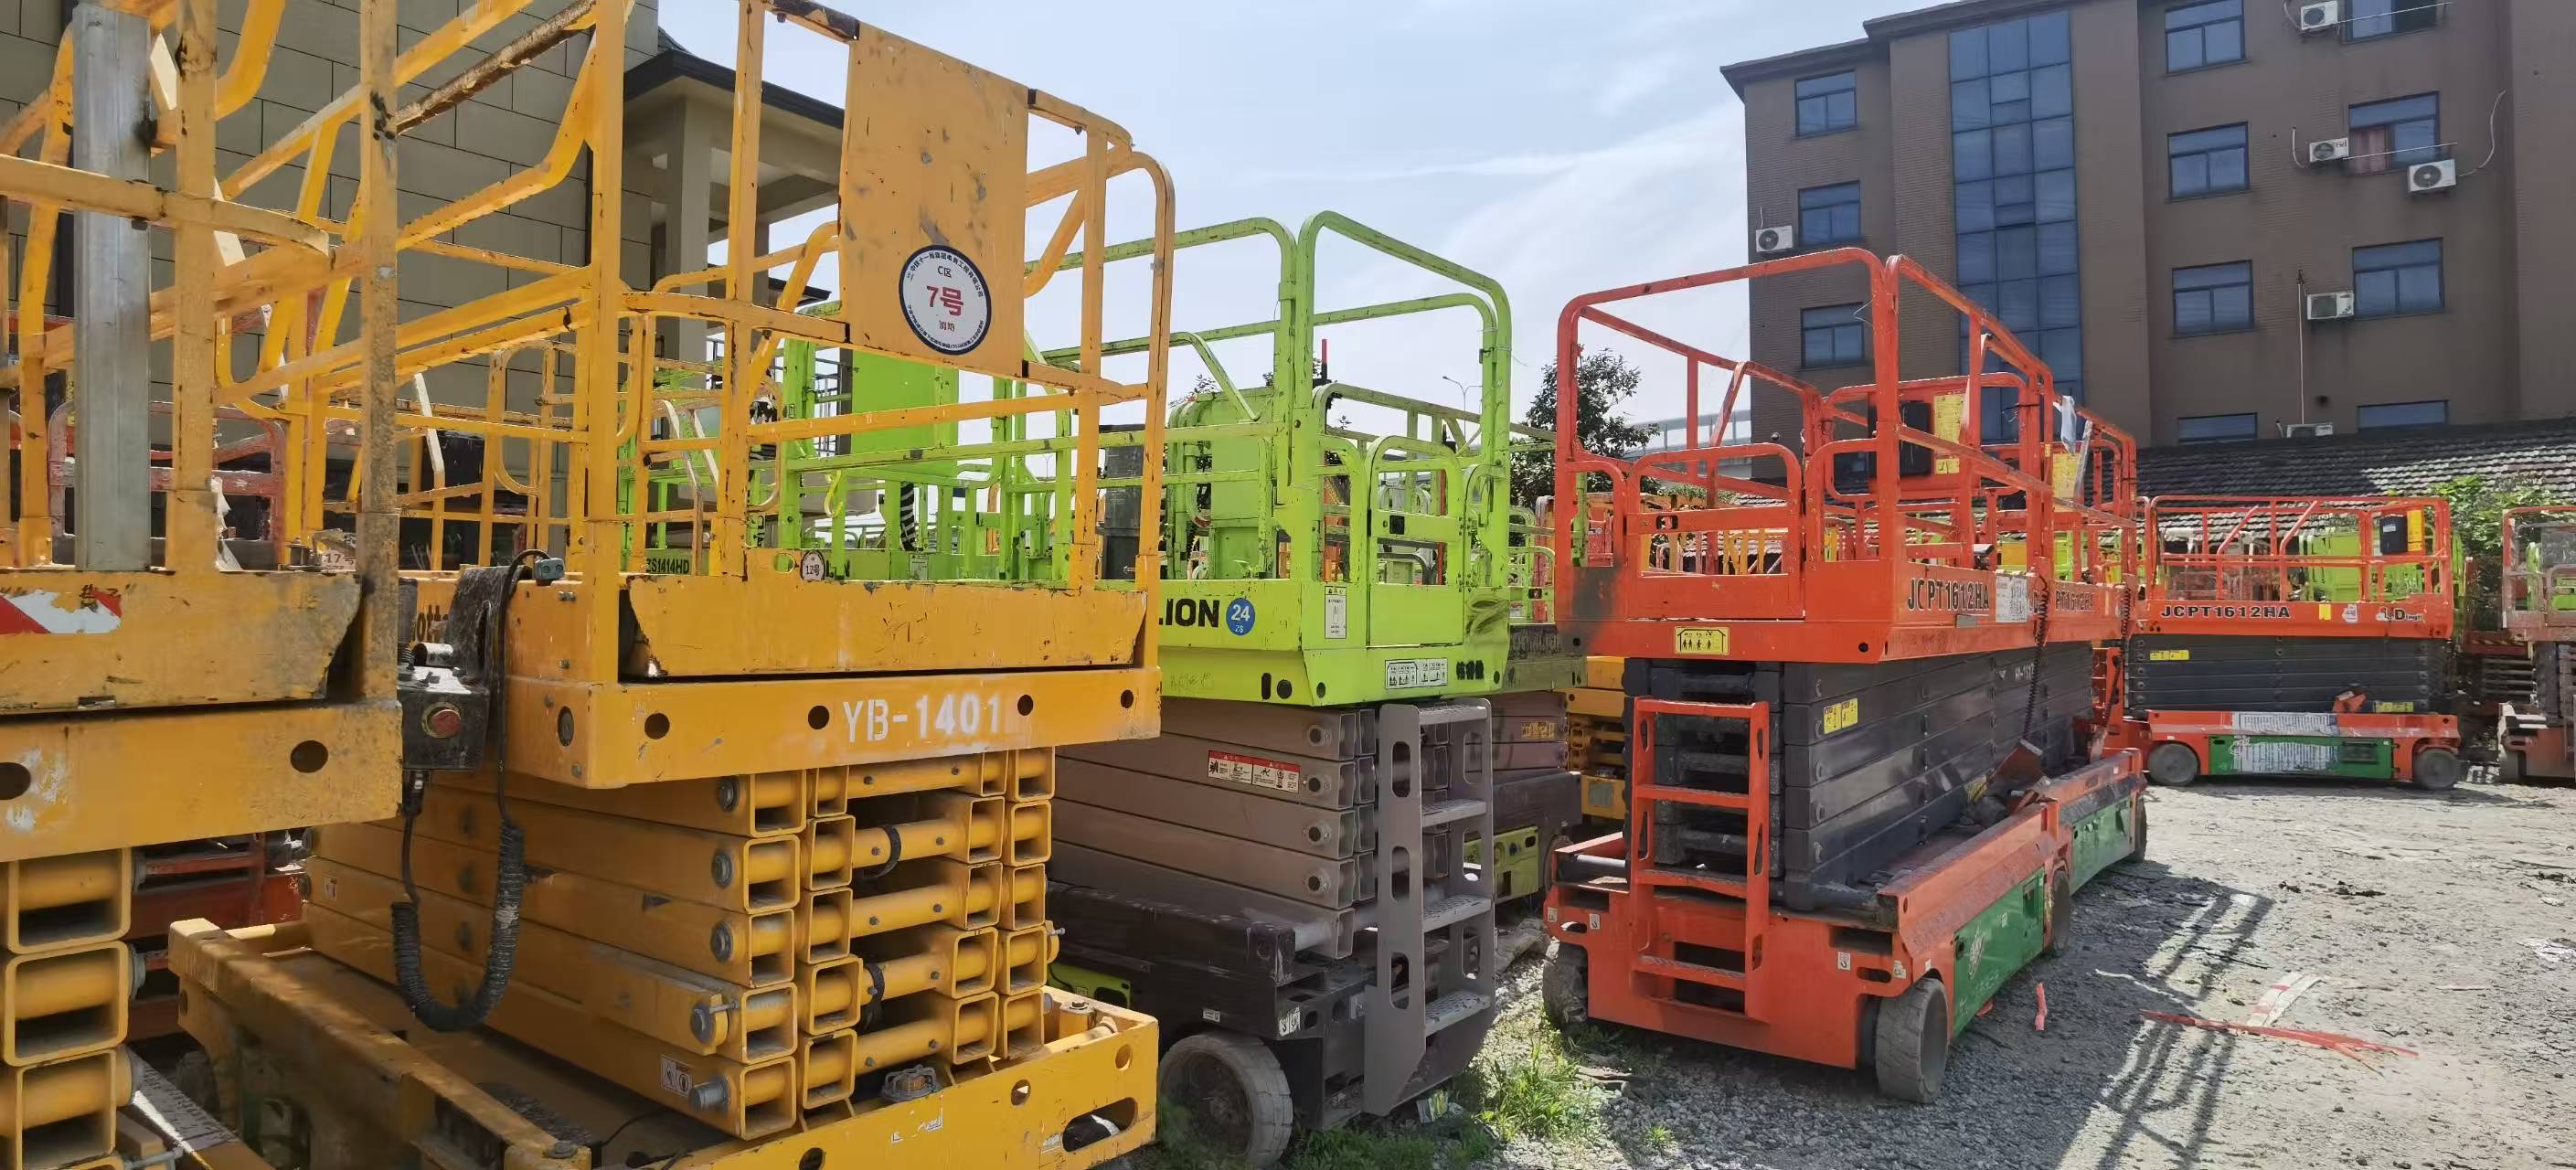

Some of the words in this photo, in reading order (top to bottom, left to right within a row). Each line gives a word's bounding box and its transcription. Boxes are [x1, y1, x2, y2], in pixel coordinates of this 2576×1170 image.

[937, 266, 953, 279] C区
[926, 286, 964, 316] 7号
[805, 564, 820, 577] 12号
[1908, 577, 1990, 612] JCPT1612HA
[1159, 598, 1220, 628] ION
[1230, 603, 1251, 622] 24
[2161, 605, 2292, 619] JCPT1612HA
[843, 693, 1001, 743] YB-1401
